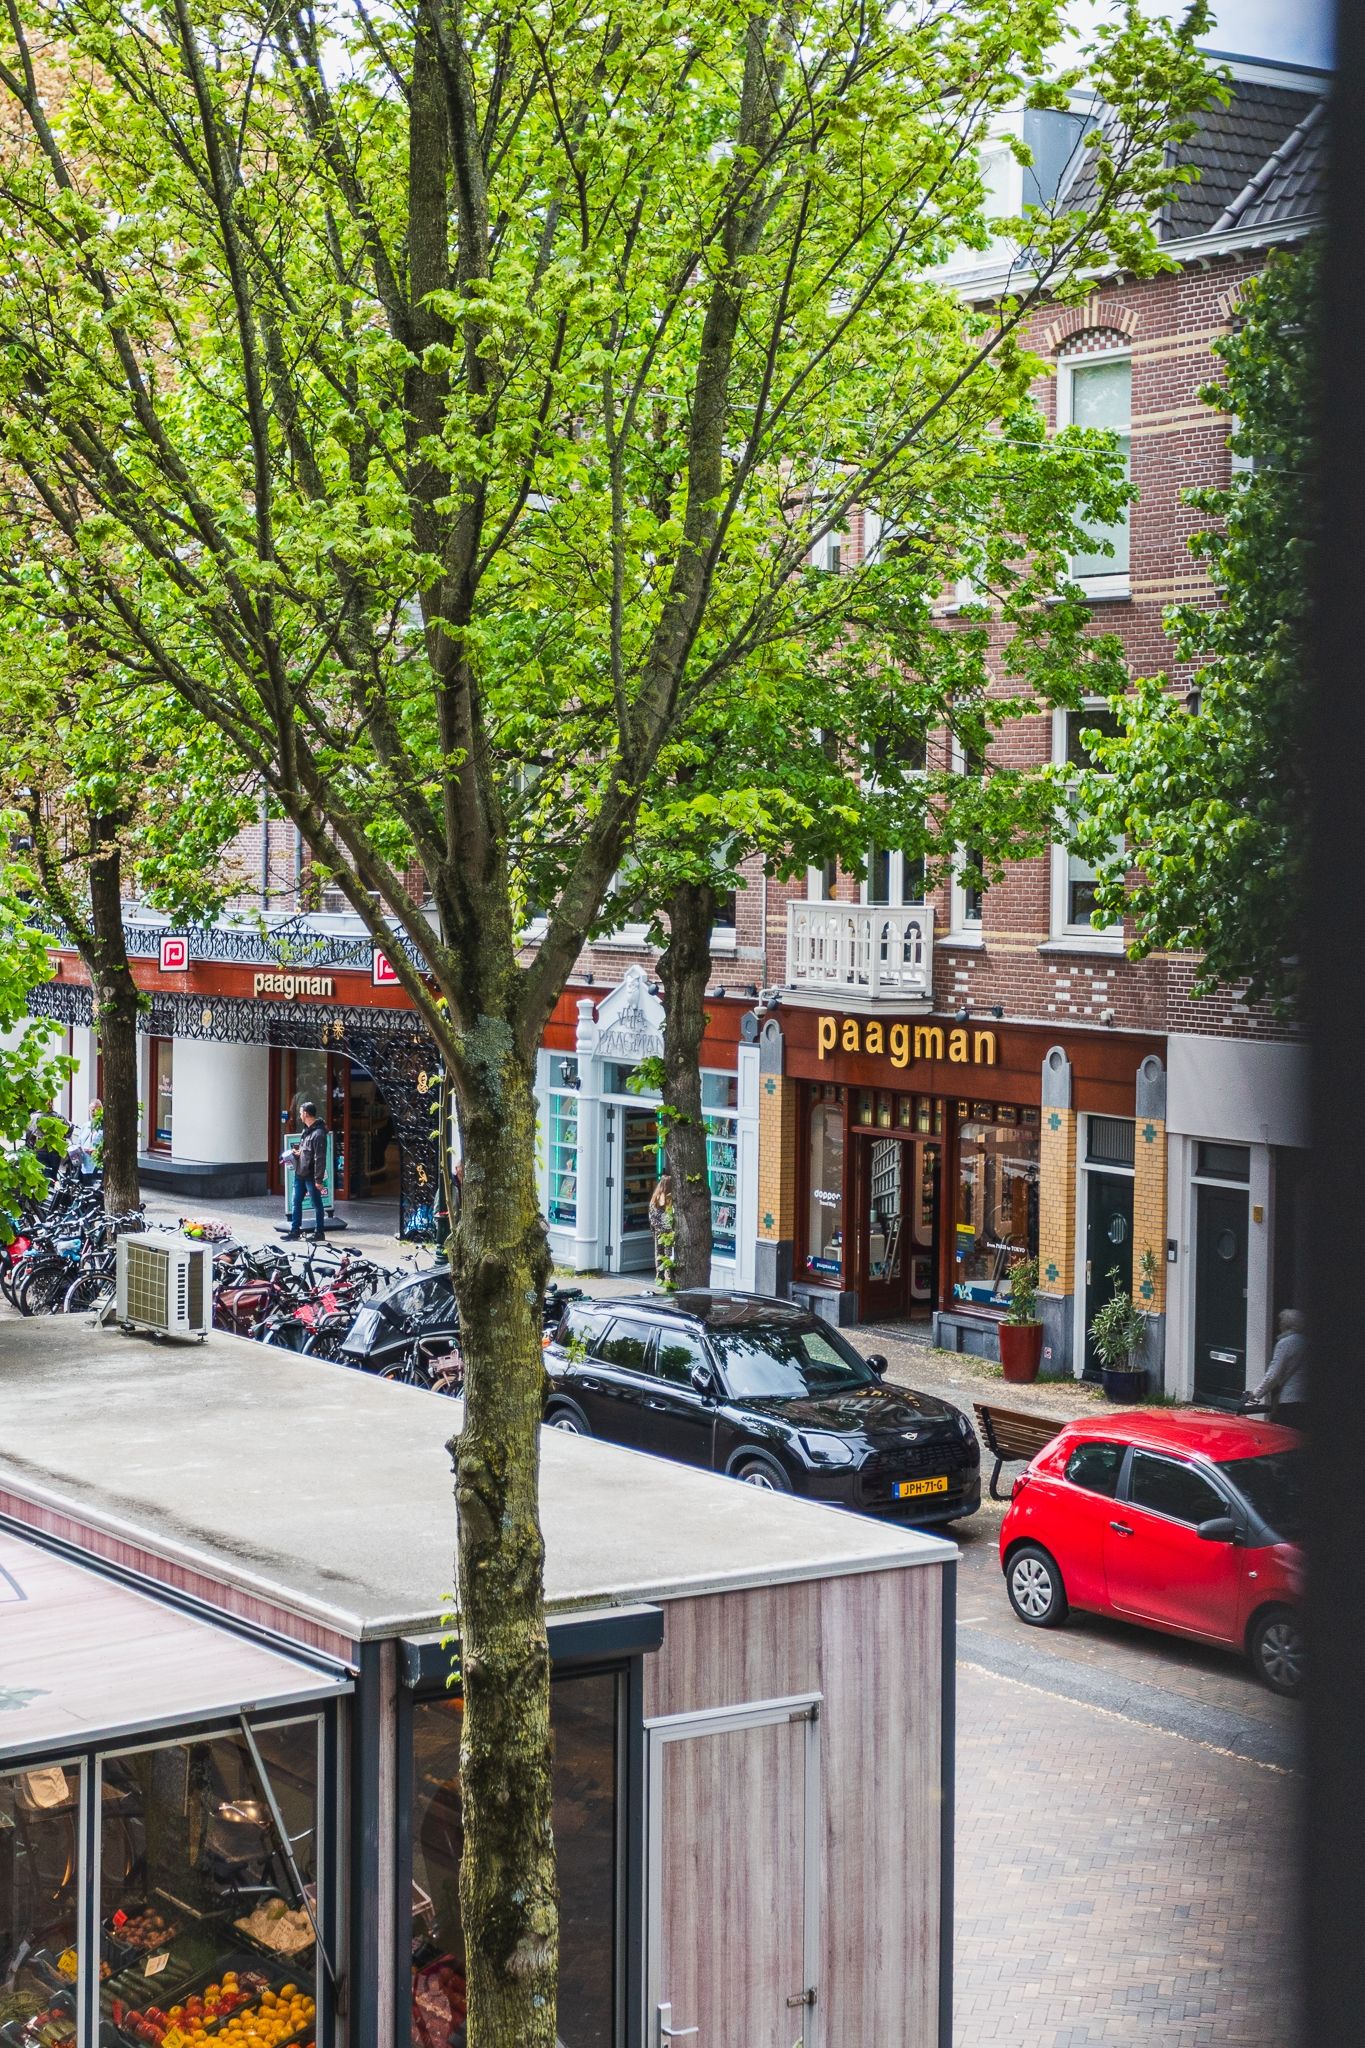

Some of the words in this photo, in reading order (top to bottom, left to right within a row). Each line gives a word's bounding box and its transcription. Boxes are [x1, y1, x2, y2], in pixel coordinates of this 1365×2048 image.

[253, 973, 333, 1000] paagman
[818, 1016, 996, 1068] paagman
[904, 1479, 943, 1495] JPH-71-G
